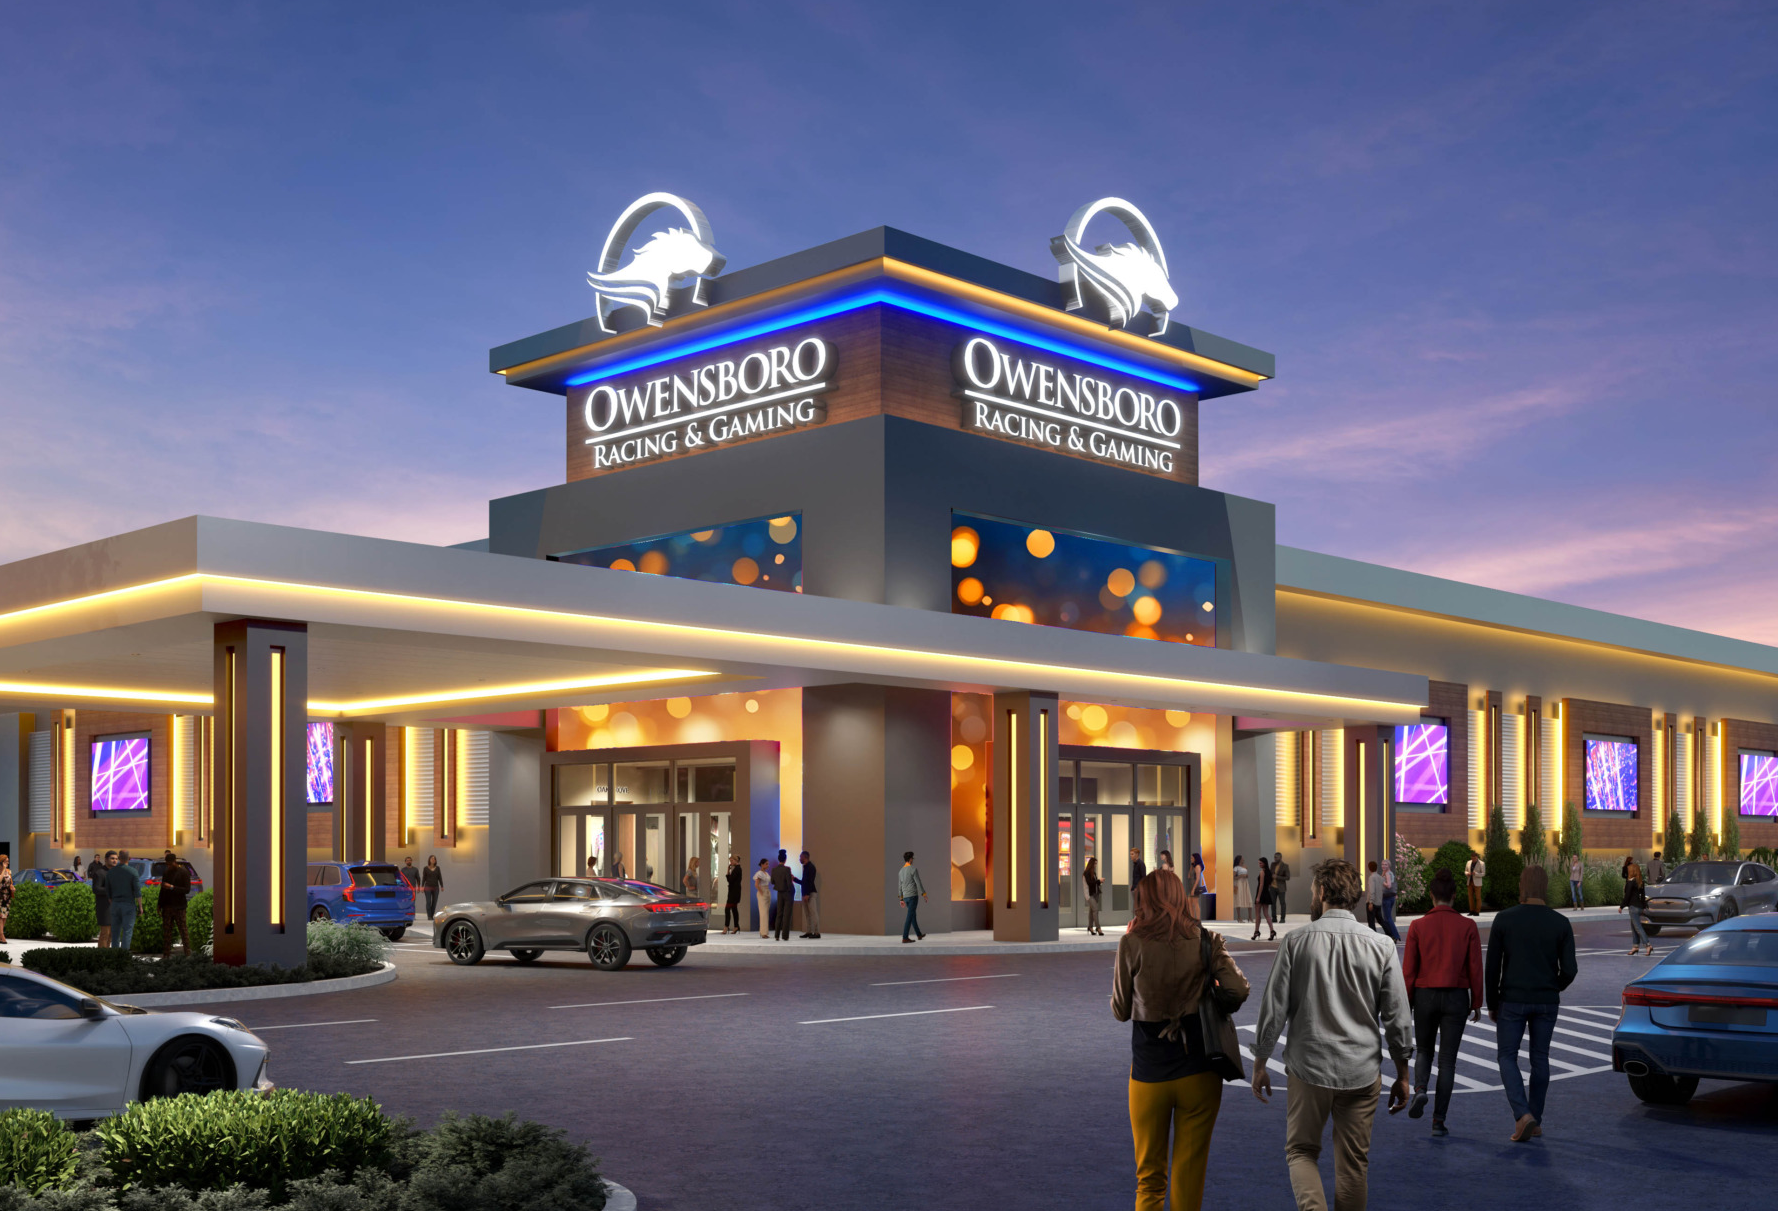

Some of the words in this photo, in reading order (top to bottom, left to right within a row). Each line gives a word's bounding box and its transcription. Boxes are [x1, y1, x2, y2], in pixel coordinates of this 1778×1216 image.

[584, 337, 827, 432] OWENSBORO
[964, 337, 1181, 437] OWENSBORO
[593, 430, 678, 469] RACING
[684, 422, 704, 448] &
[708, 398, 815, 442] GAMING
[974, 401, 1061, 446] RACING
[1067, 425, 1086, 452] &
[1089, 431, 1173, 473] GAMING
